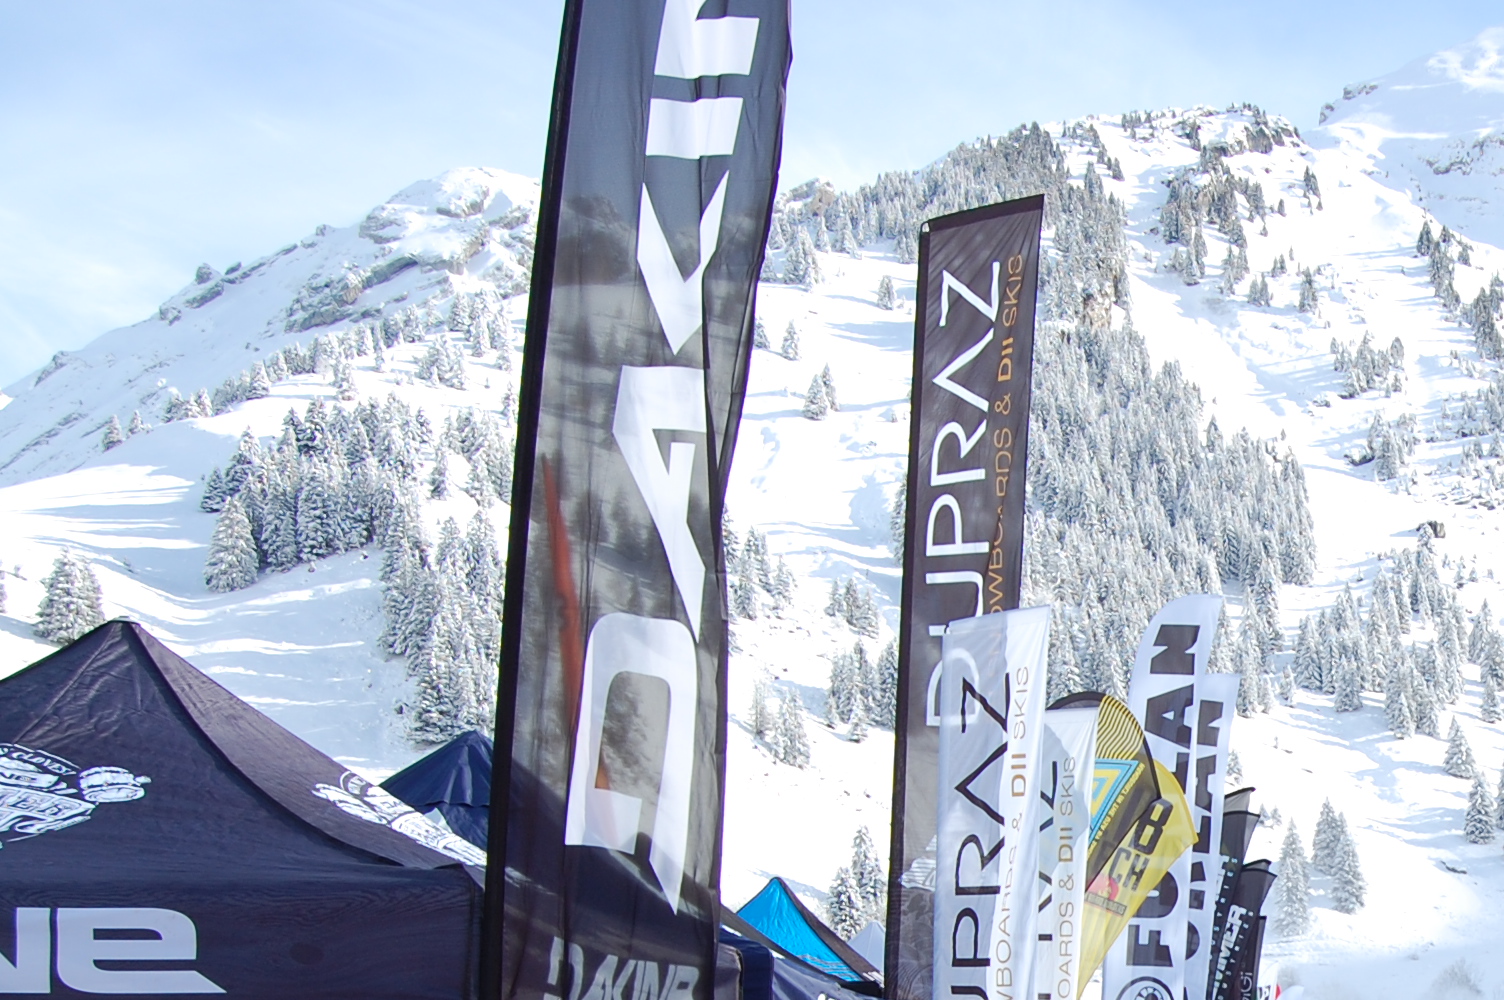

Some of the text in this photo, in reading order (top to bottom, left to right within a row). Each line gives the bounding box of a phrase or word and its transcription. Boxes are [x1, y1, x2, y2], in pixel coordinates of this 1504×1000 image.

[1003, 254, 1024, 327] SKIS
[1013, 666, 1029, 740] SKIS
[1059, 756, 1076, 817] SKIS
[1127, 624, 1201, 968] FULAN
